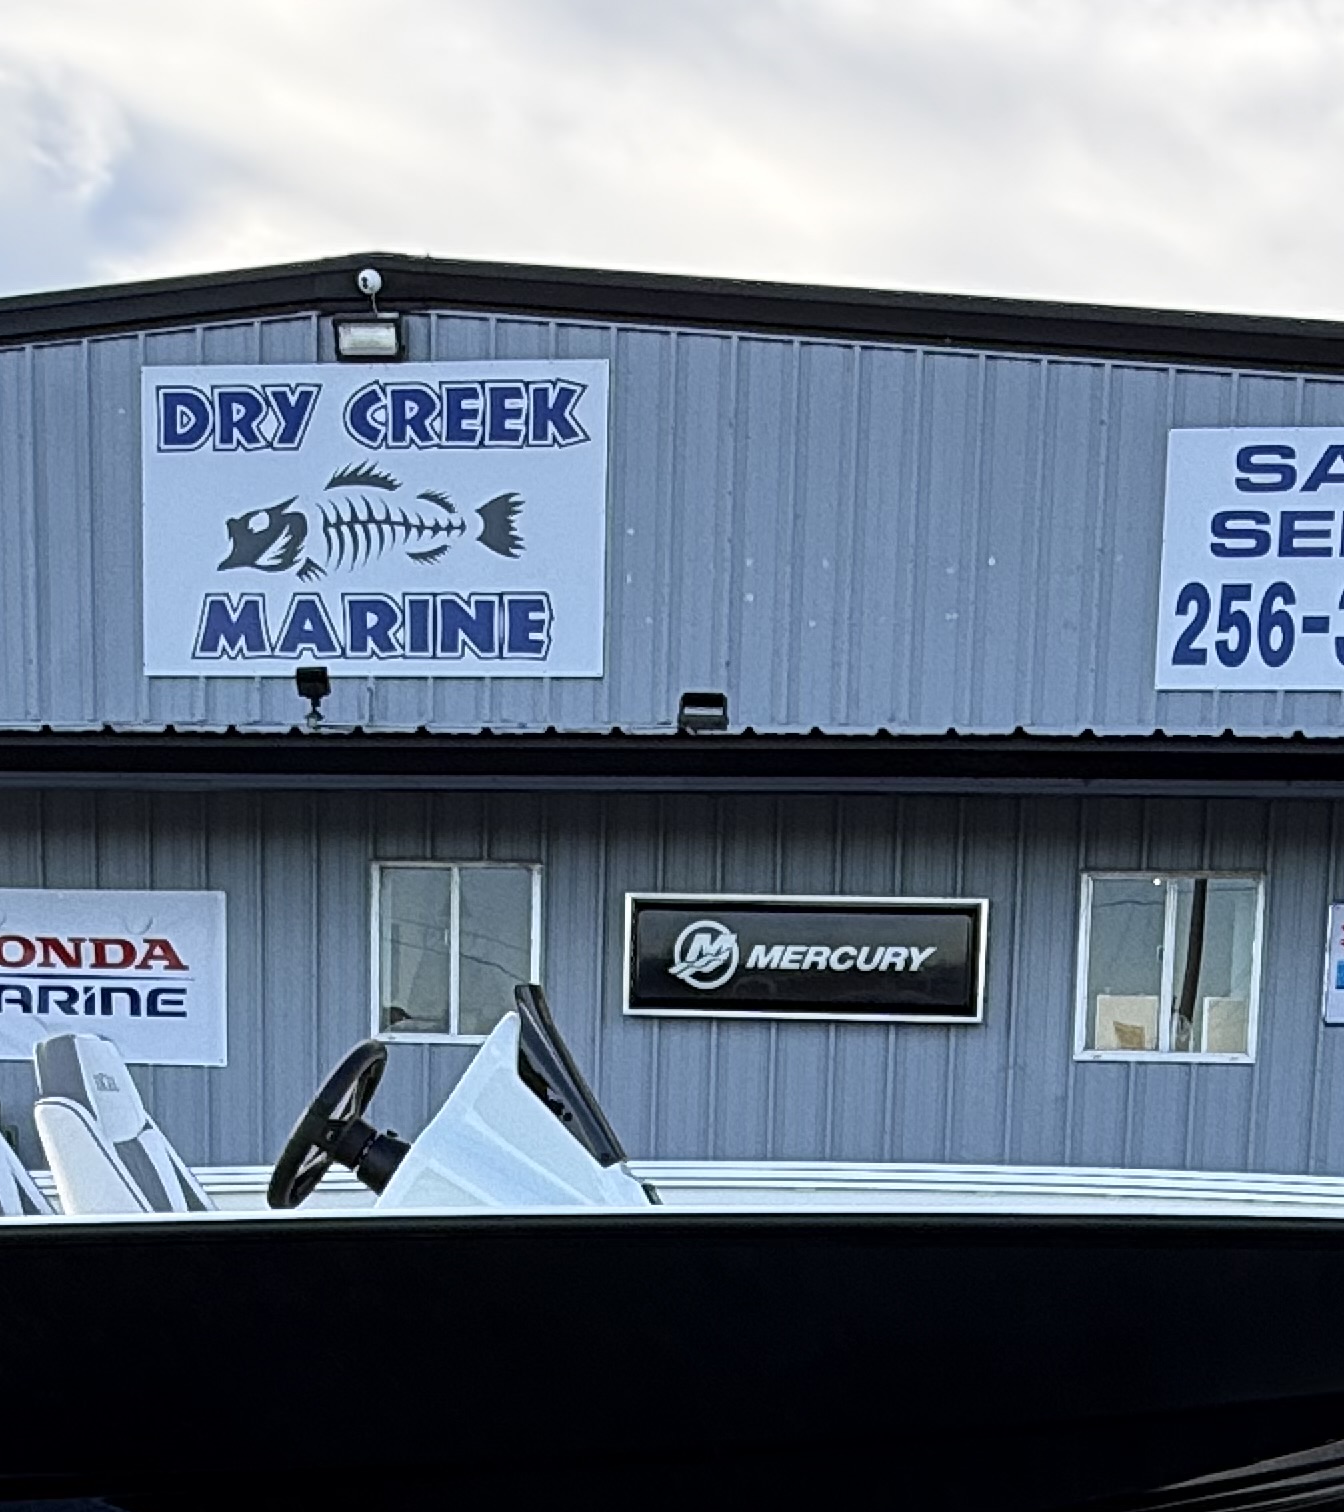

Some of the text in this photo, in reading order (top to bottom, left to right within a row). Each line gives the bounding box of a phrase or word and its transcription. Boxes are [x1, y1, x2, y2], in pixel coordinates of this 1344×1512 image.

[156, 378, 591, 452] DRY CREEK
[191, 591, 554, 660] MARINE
[745, 944, 937, 972] MERCURY
